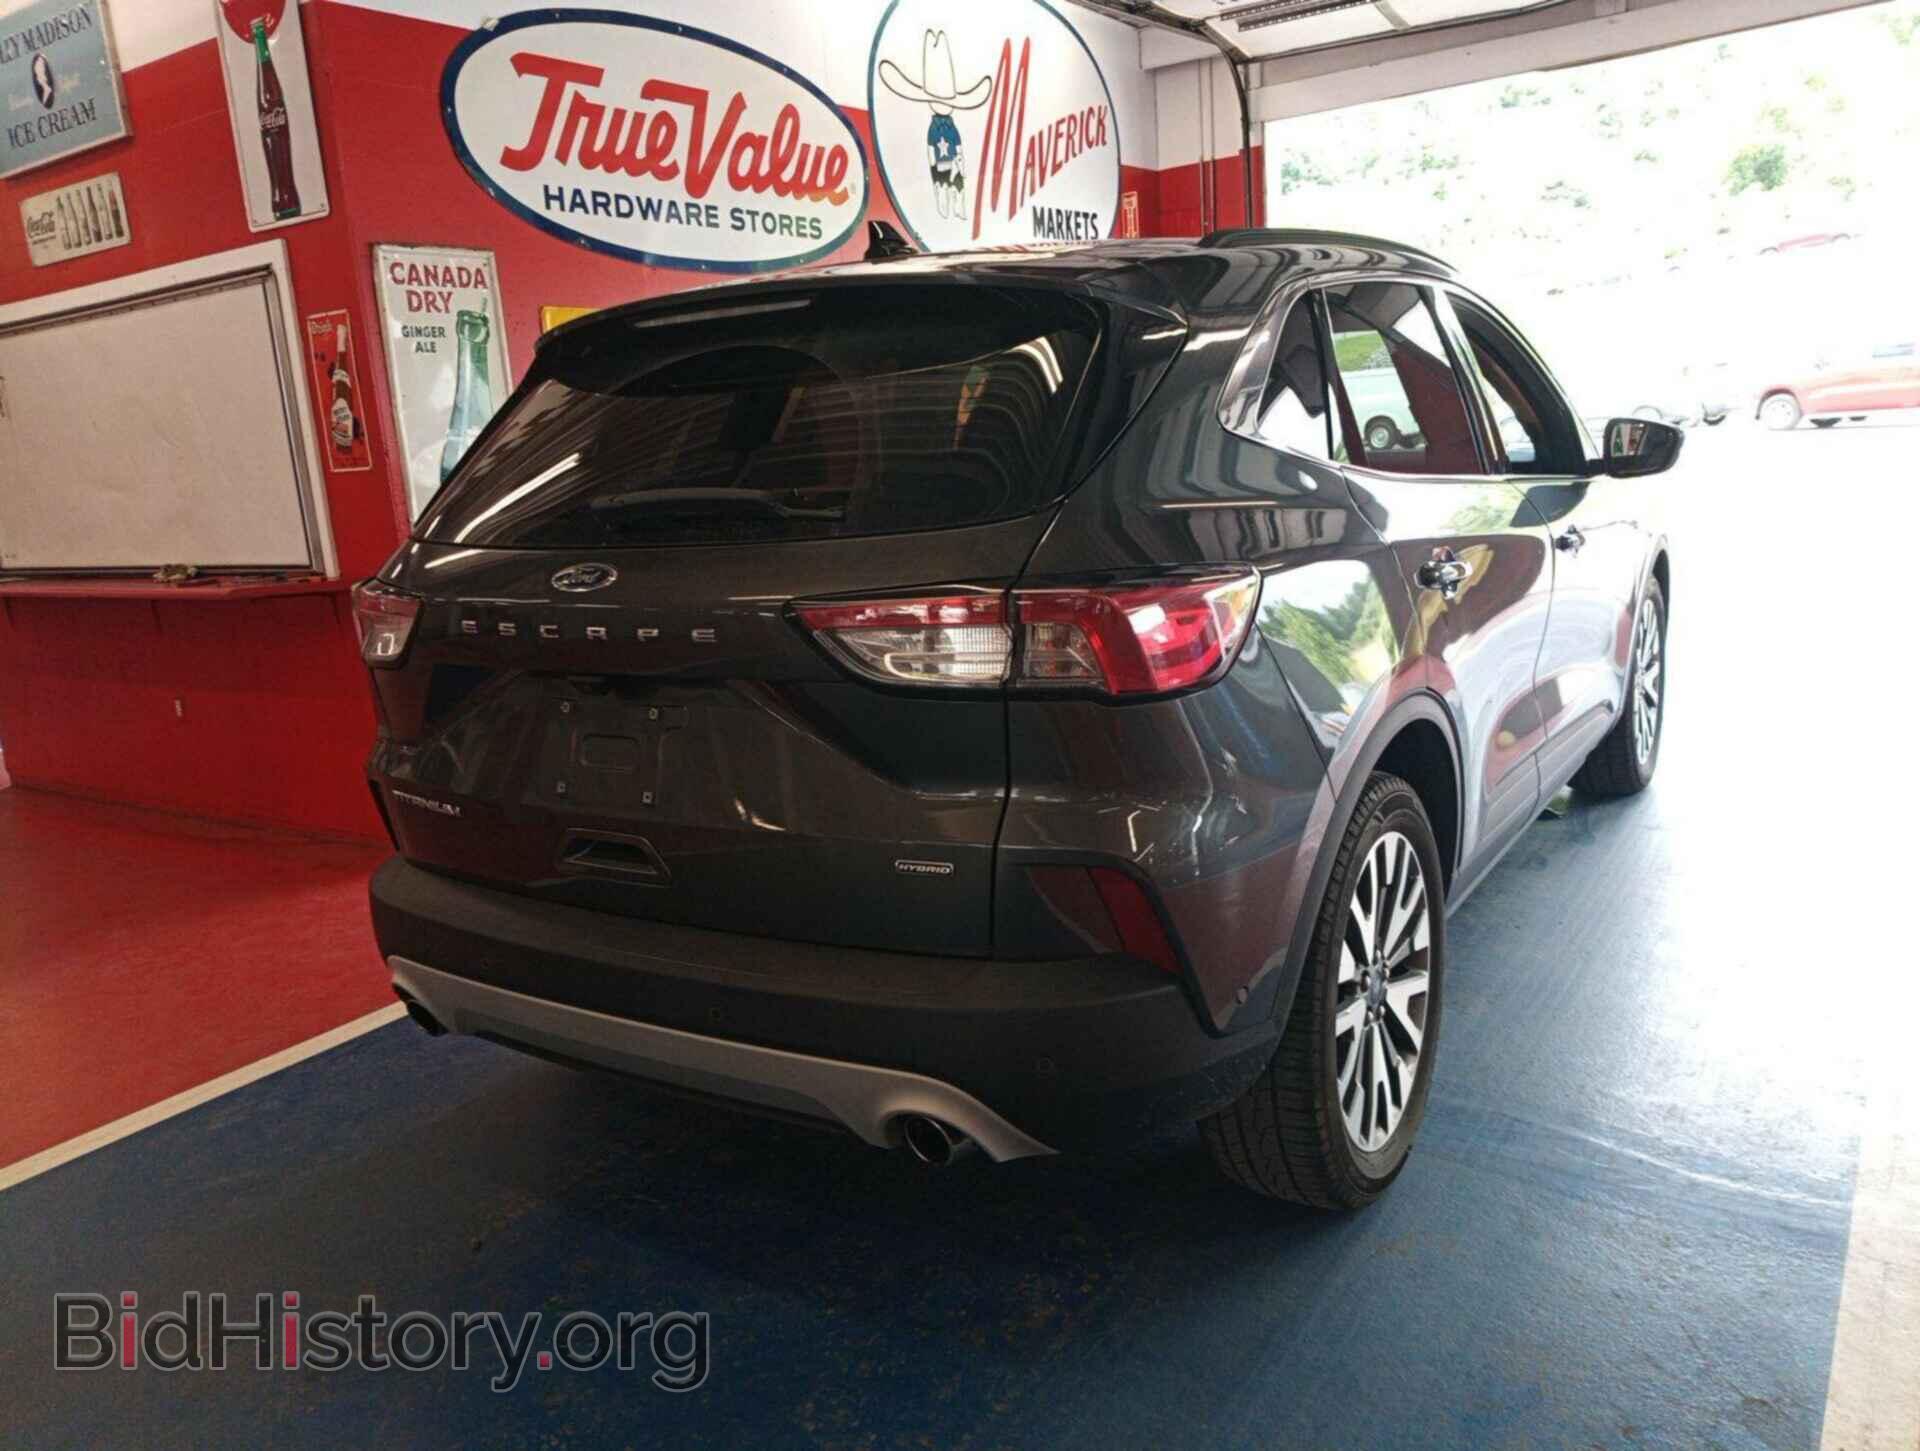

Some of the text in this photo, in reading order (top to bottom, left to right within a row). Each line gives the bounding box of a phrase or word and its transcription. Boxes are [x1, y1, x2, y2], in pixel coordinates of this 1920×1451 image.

[21, 6, 94, 50] MADISON
[7, 121, 36, 149] ICE
[37, 97, 98, 139] CREAM
[971, 35, 1108, 240] MAVERICK
[543, 185, 824, 240] HARDWARE STORES
[1032, 205, 1098, 241] MARKETS
[389, 262, 488, 289] CANADA
[406, 290, 454, 314] DRY
[401, 325, 447, 339] GINGER
[415, 341, 437, 354] ALE
[461, 619, 717, 643] ESCAPE
[898, 863, 950, 874] HYBRID
